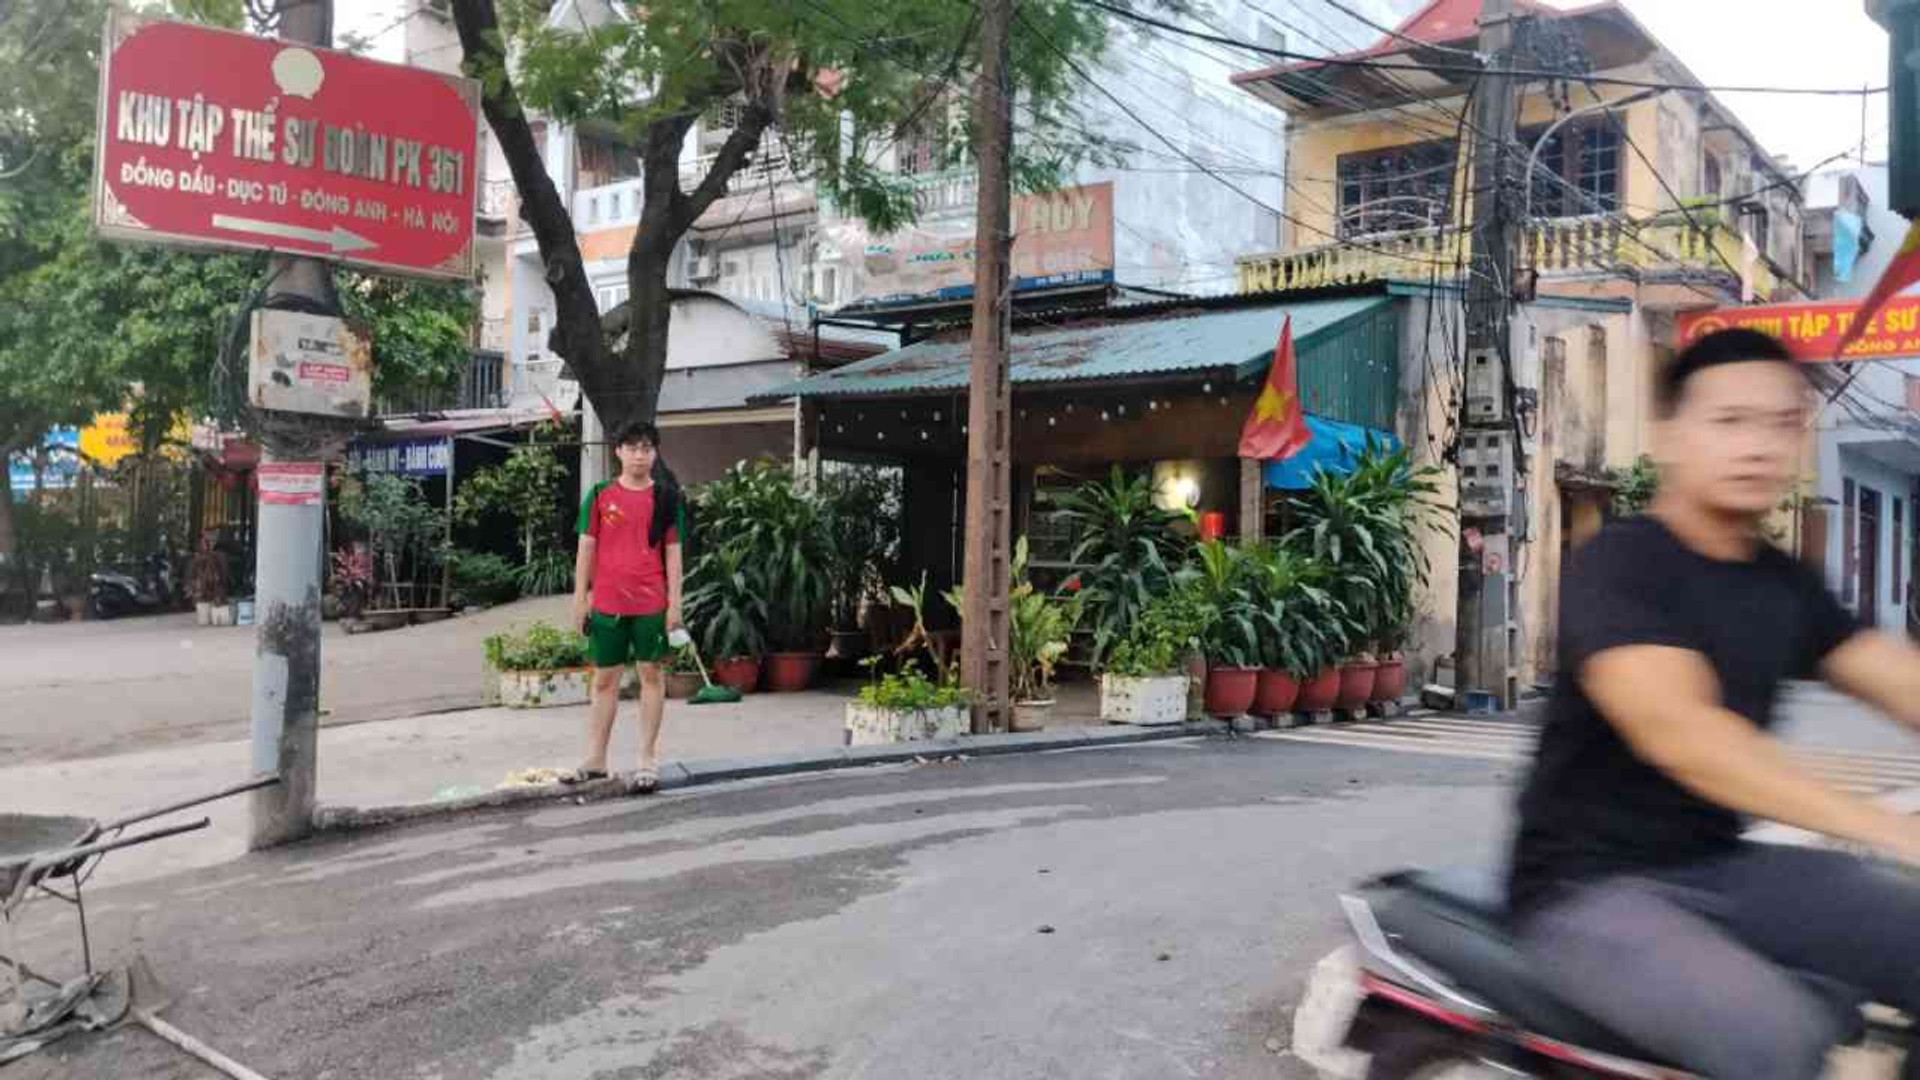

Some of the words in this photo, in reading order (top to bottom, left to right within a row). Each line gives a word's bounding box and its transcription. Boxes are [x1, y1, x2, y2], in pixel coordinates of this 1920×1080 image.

[117, 90, 172, 147] KHU
[176, 93, 224, 160] TẬP
[231, 96, 279, 162] THỂ
[392, 138, 421, 188] PK
[354, 199, 387, 222] ANH
[1788, 311, 1831, 343] TẬP
[1885, 304, 1920, 333] SƯ
